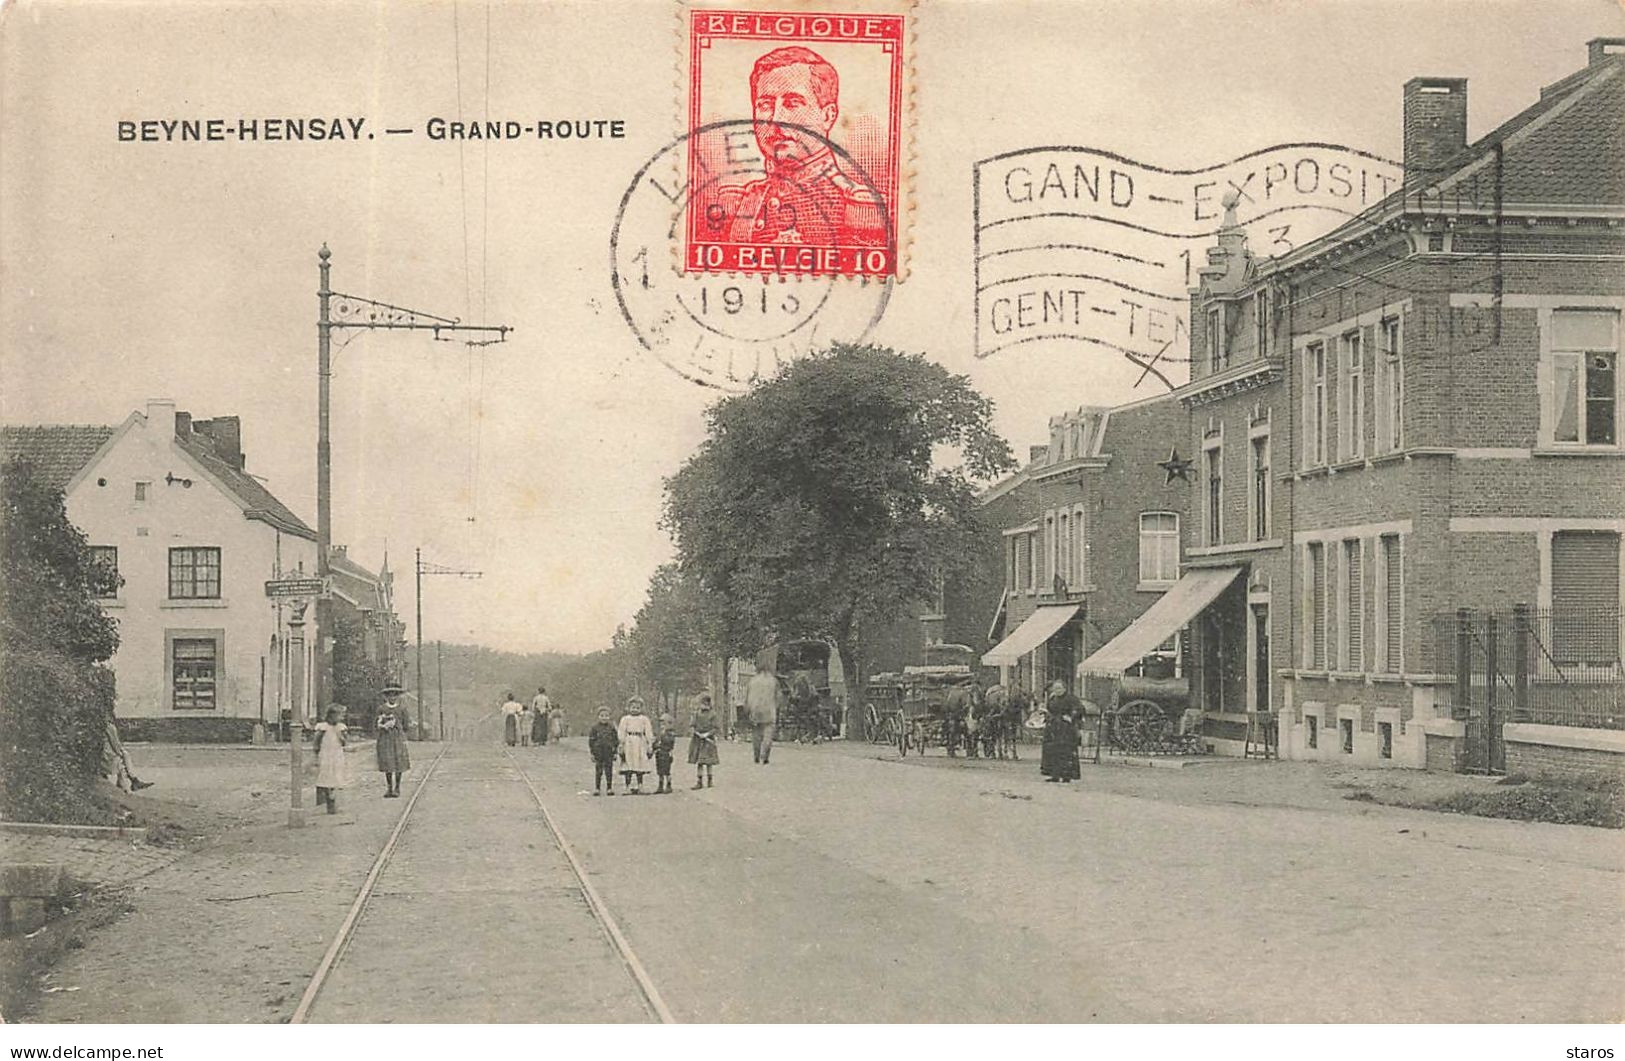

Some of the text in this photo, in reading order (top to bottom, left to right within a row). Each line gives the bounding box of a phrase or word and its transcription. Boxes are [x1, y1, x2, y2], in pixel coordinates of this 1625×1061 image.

[708, 15, 884, 38] BELGIQUE
[694, 245, 887, 272] 10 BELGIE 10
